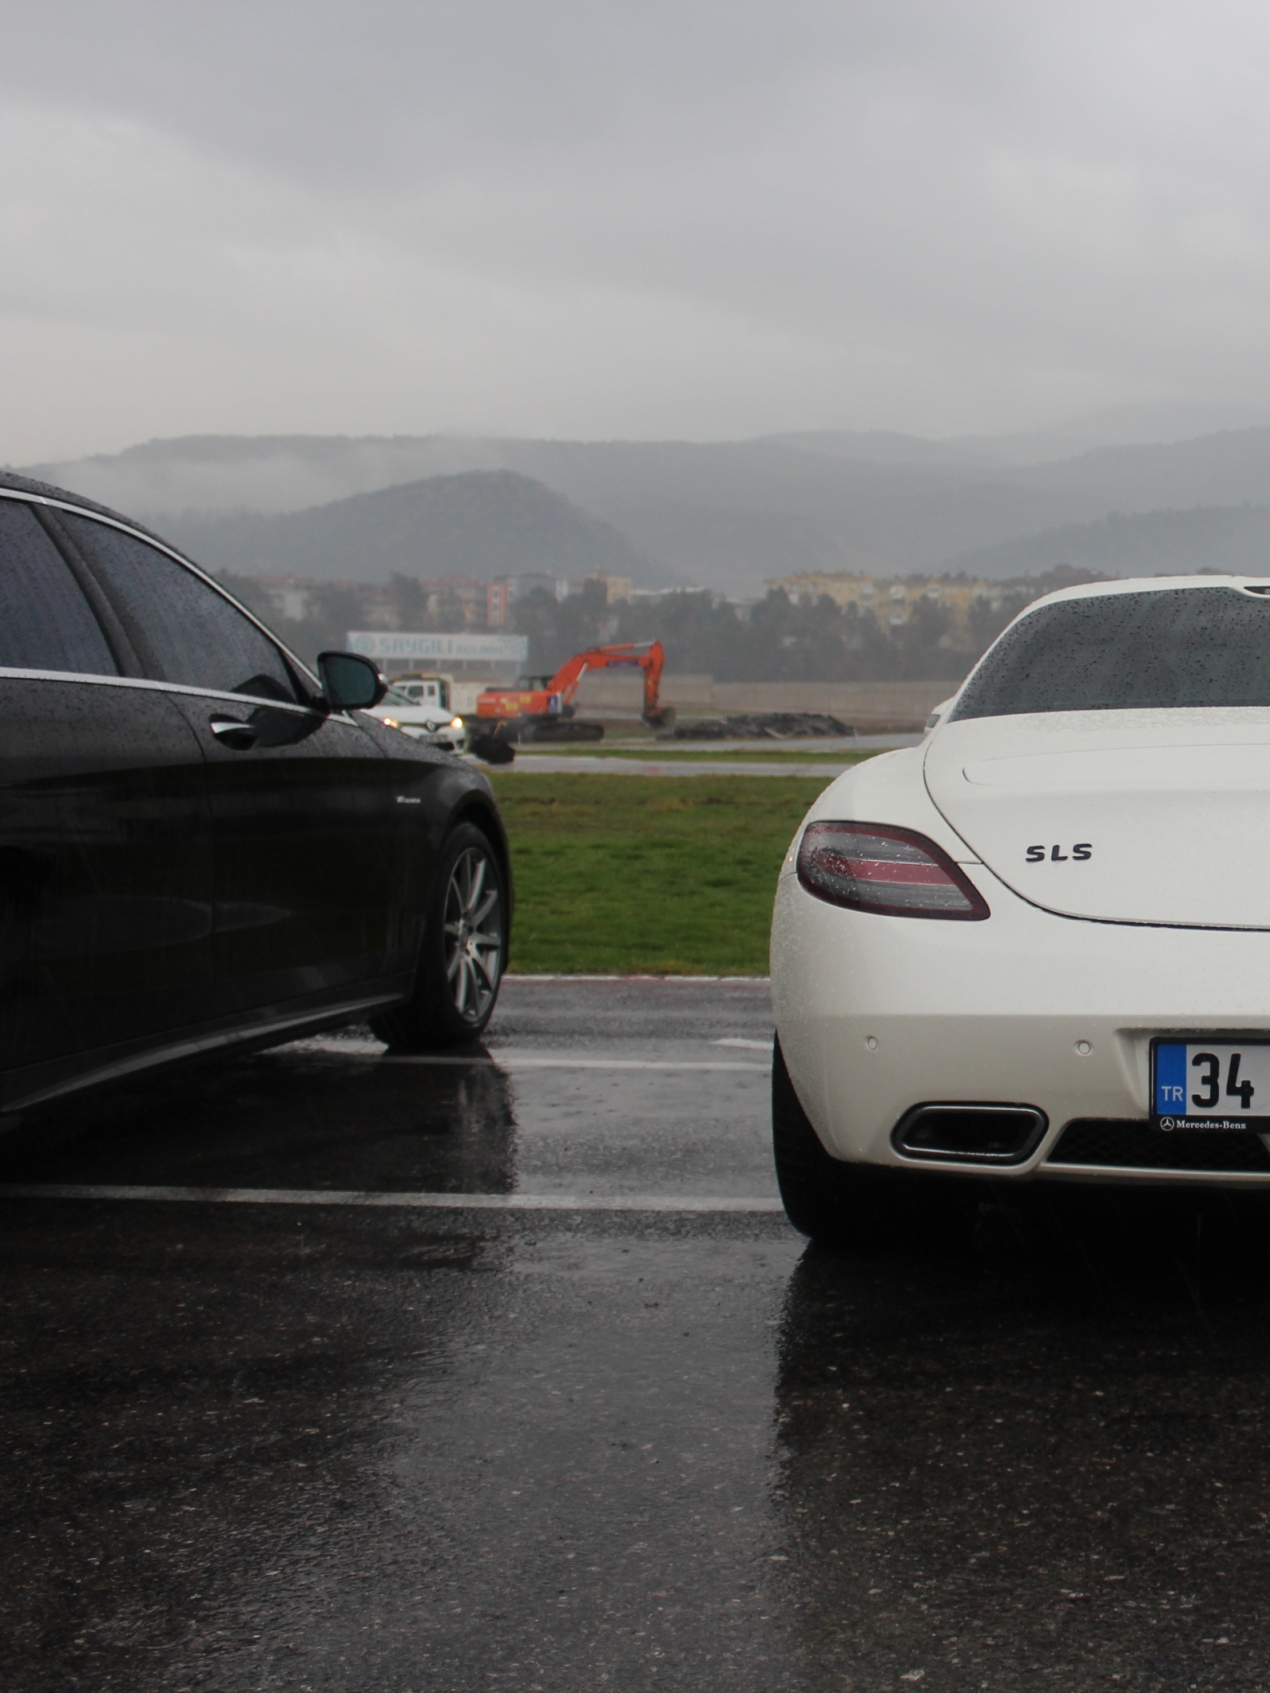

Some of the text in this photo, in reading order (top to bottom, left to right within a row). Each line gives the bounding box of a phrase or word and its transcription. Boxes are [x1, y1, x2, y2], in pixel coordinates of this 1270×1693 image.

[1025, 843, 1092, 862] SLS
[1191, 1053, 1255, 1109] 34
[1161, 1086, 1184, 1102] TR
[1176, 1120, 1247, 1130] Mercedes-Benz
